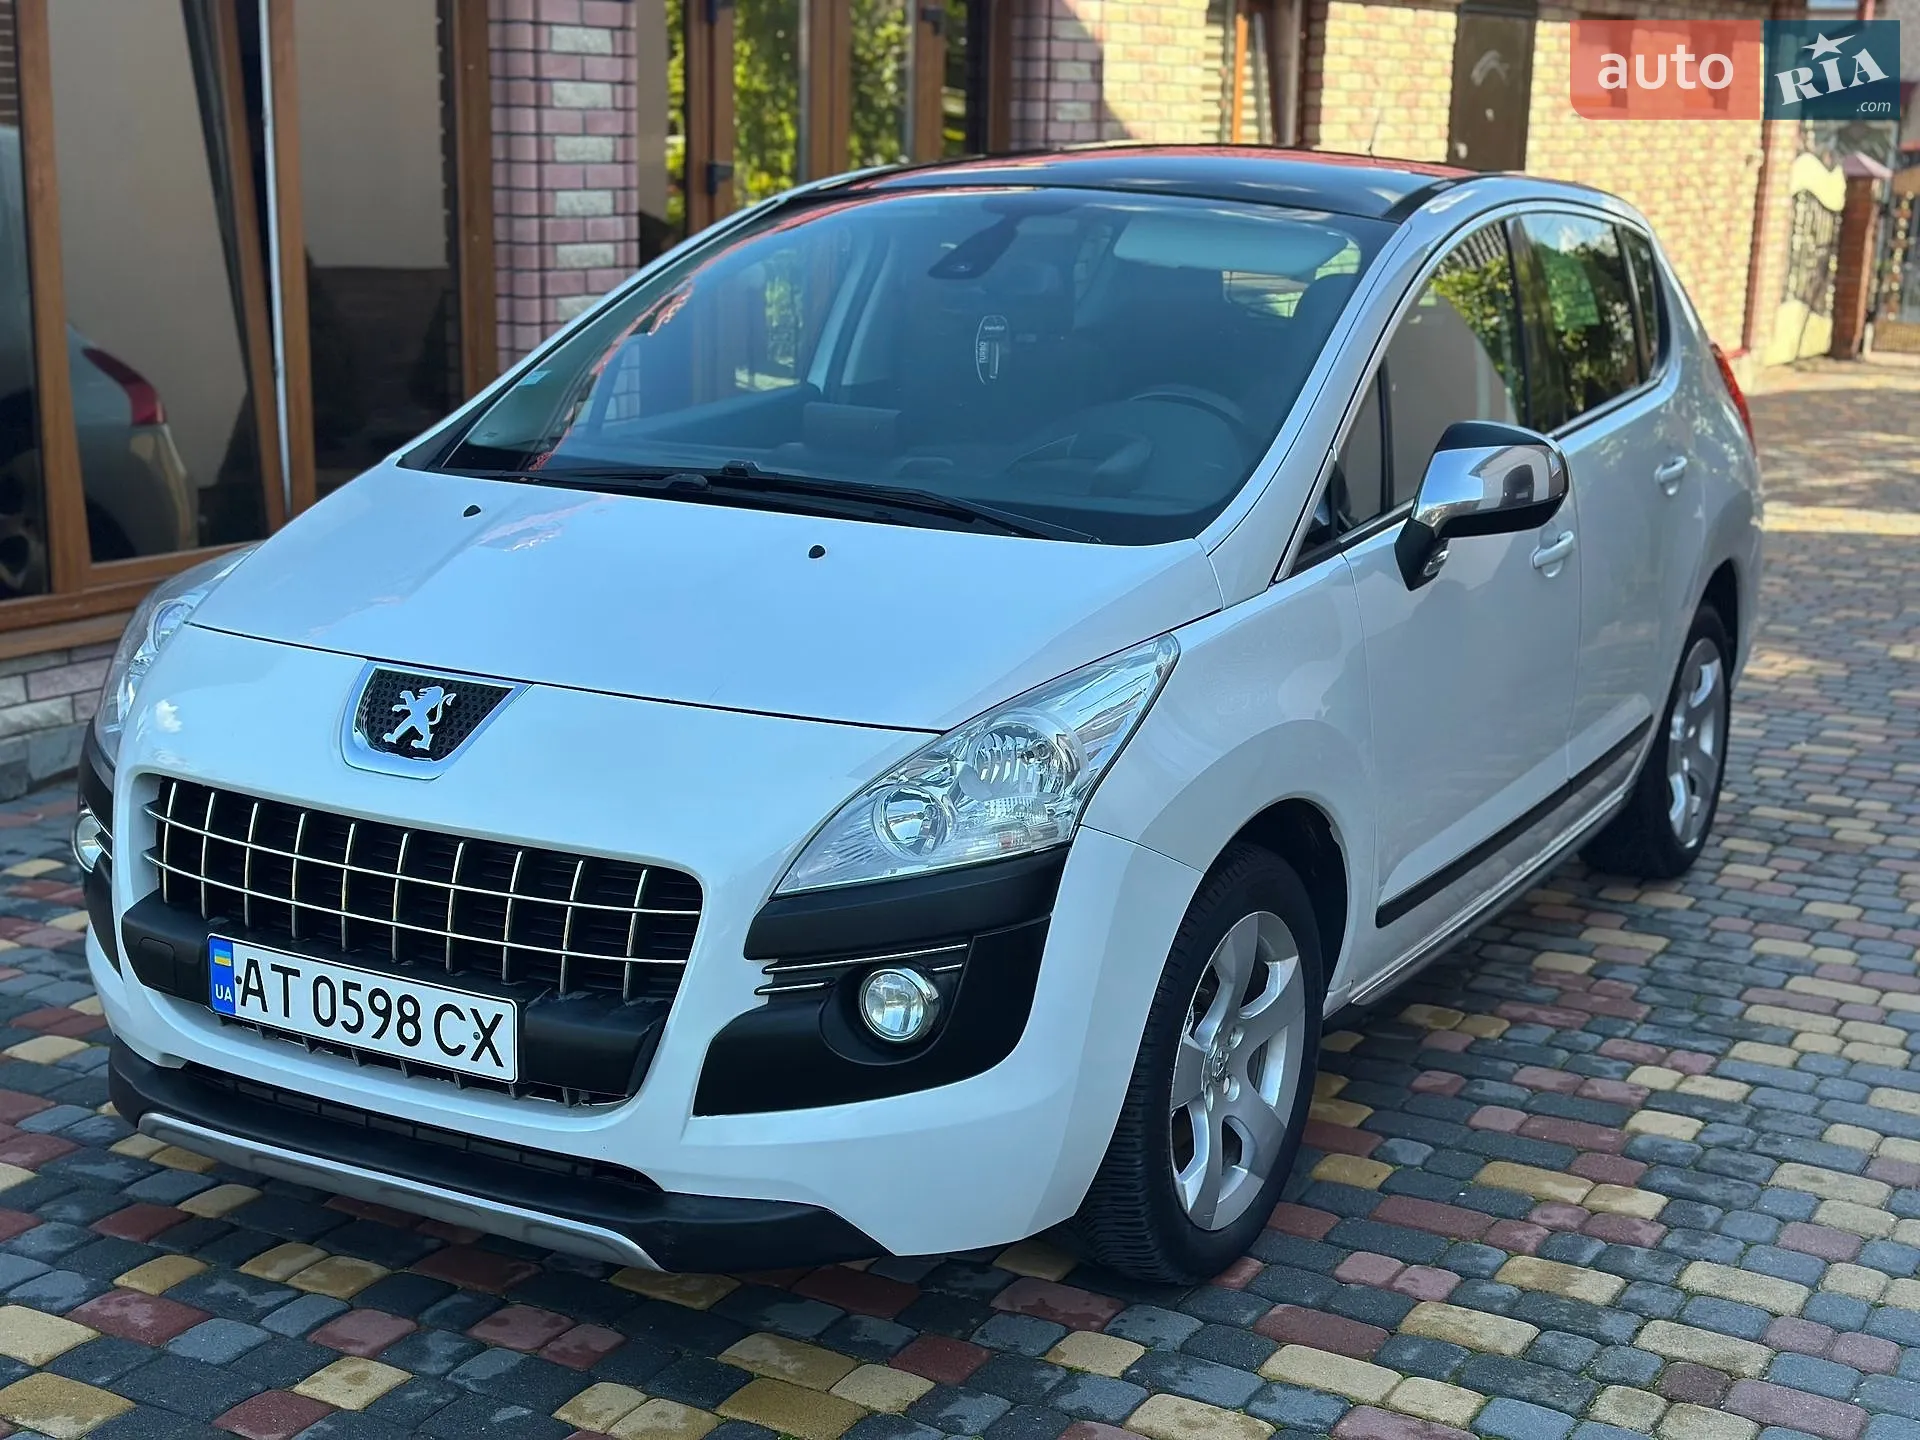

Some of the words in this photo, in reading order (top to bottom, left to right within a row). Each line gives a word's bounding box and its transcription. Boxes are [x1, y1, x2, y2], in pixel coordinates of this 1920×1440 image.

[215, 984, 232, 1003] UA
[241, 959, 300, 1017] AT
[313, 975, 421, 1047] 0598
[434, 1004, 503, 1067] CX
